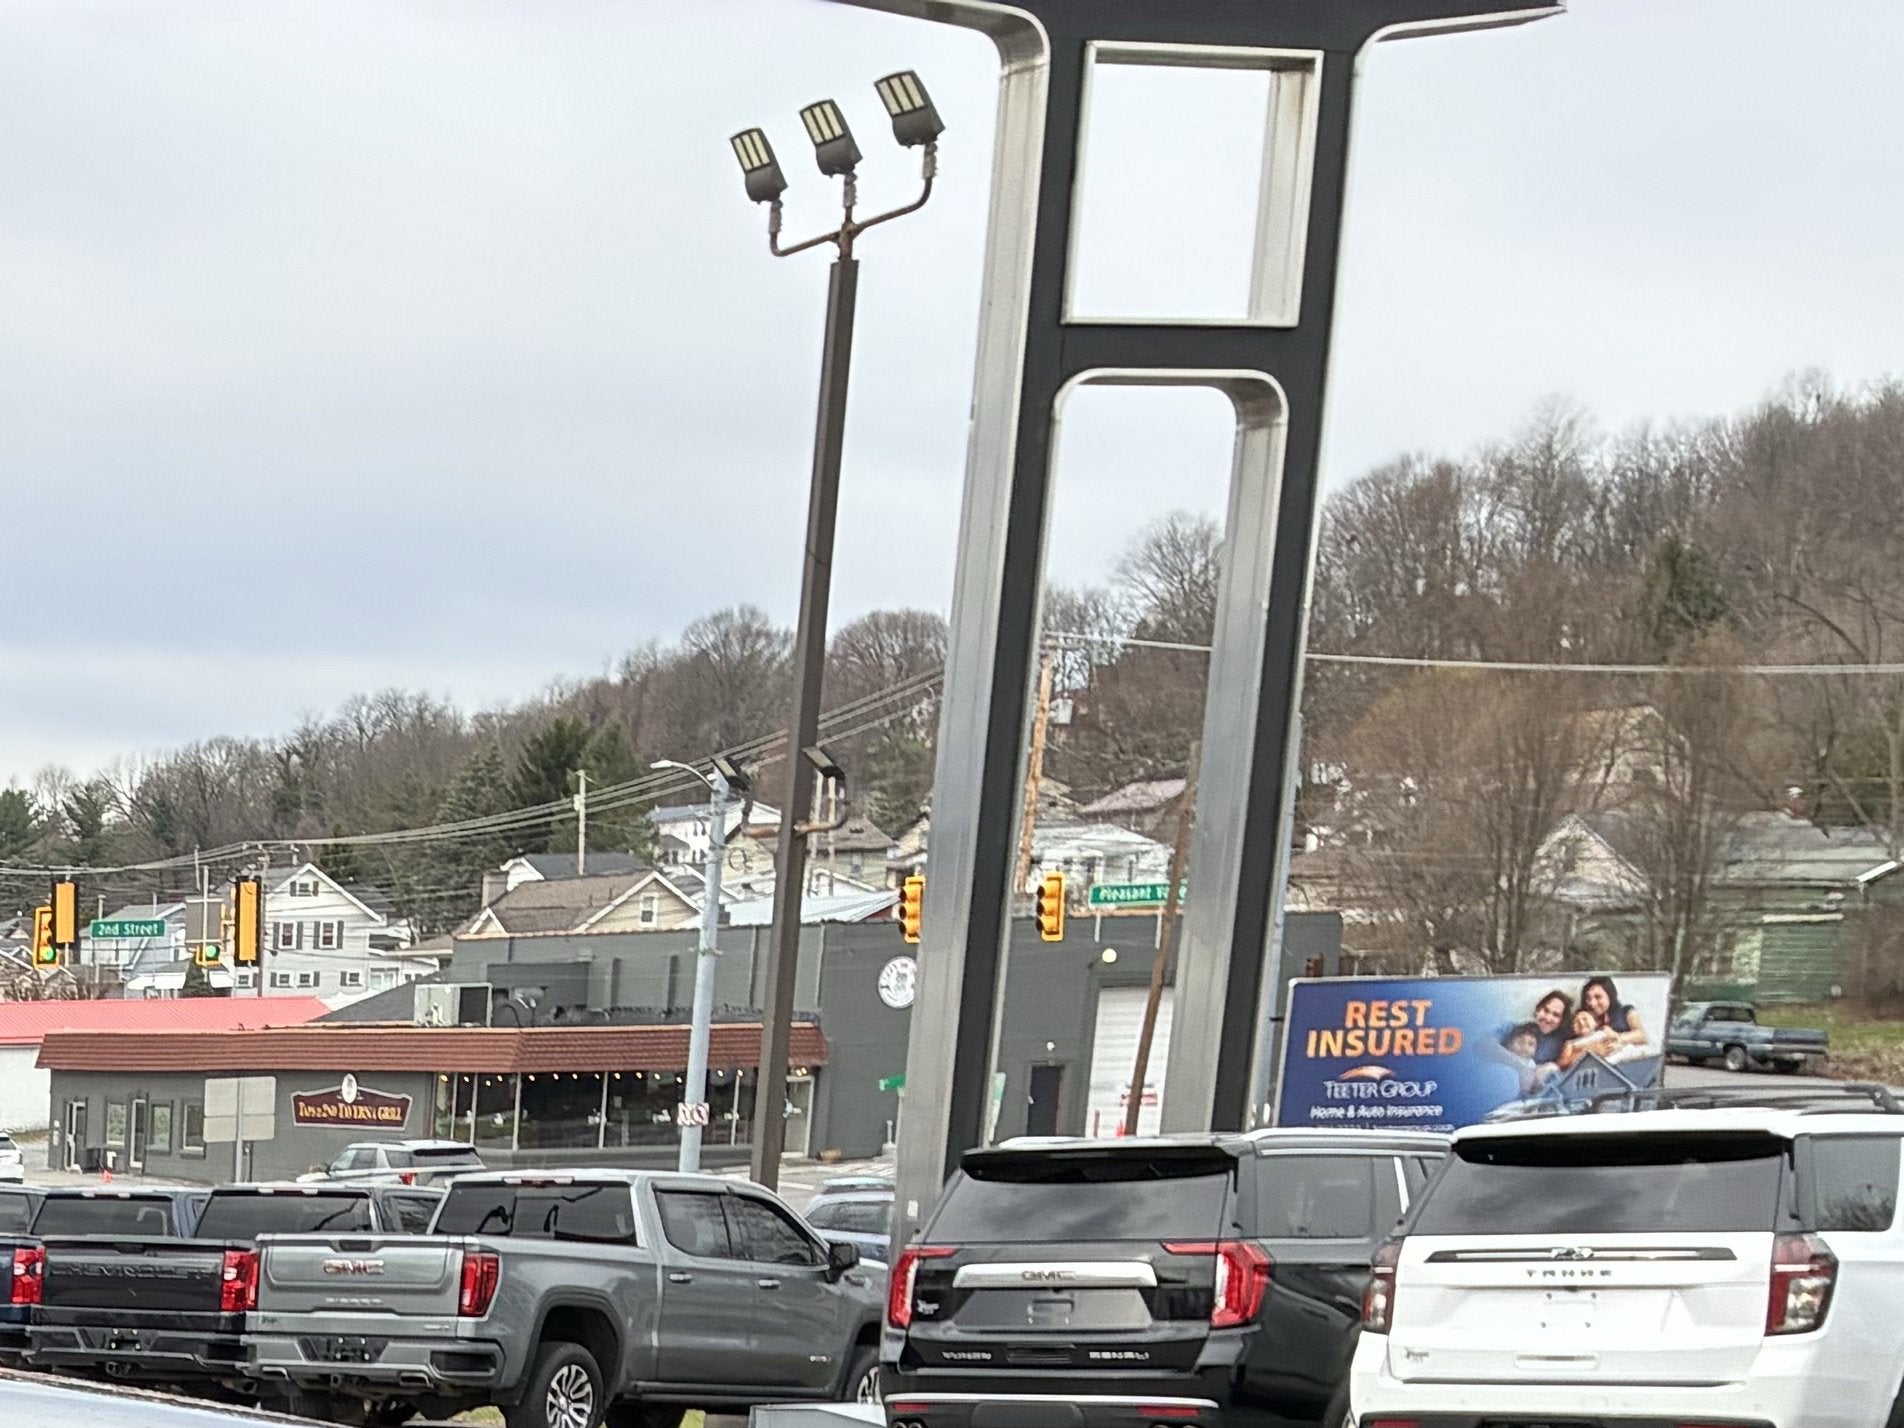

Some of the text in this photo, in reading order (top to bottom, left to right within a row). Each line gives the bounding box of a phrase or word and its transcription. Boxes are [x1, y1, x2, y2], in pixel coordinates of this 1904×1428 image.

[98, 923, 159, 936] 2nd Street
[1344, 999, 1434, 1029] REST
[1306, 1026, 1464, 1058] INSURED
[322, 1259, 385, 1275] GMC
[1021, 1270, 1076, 1281] GMC
